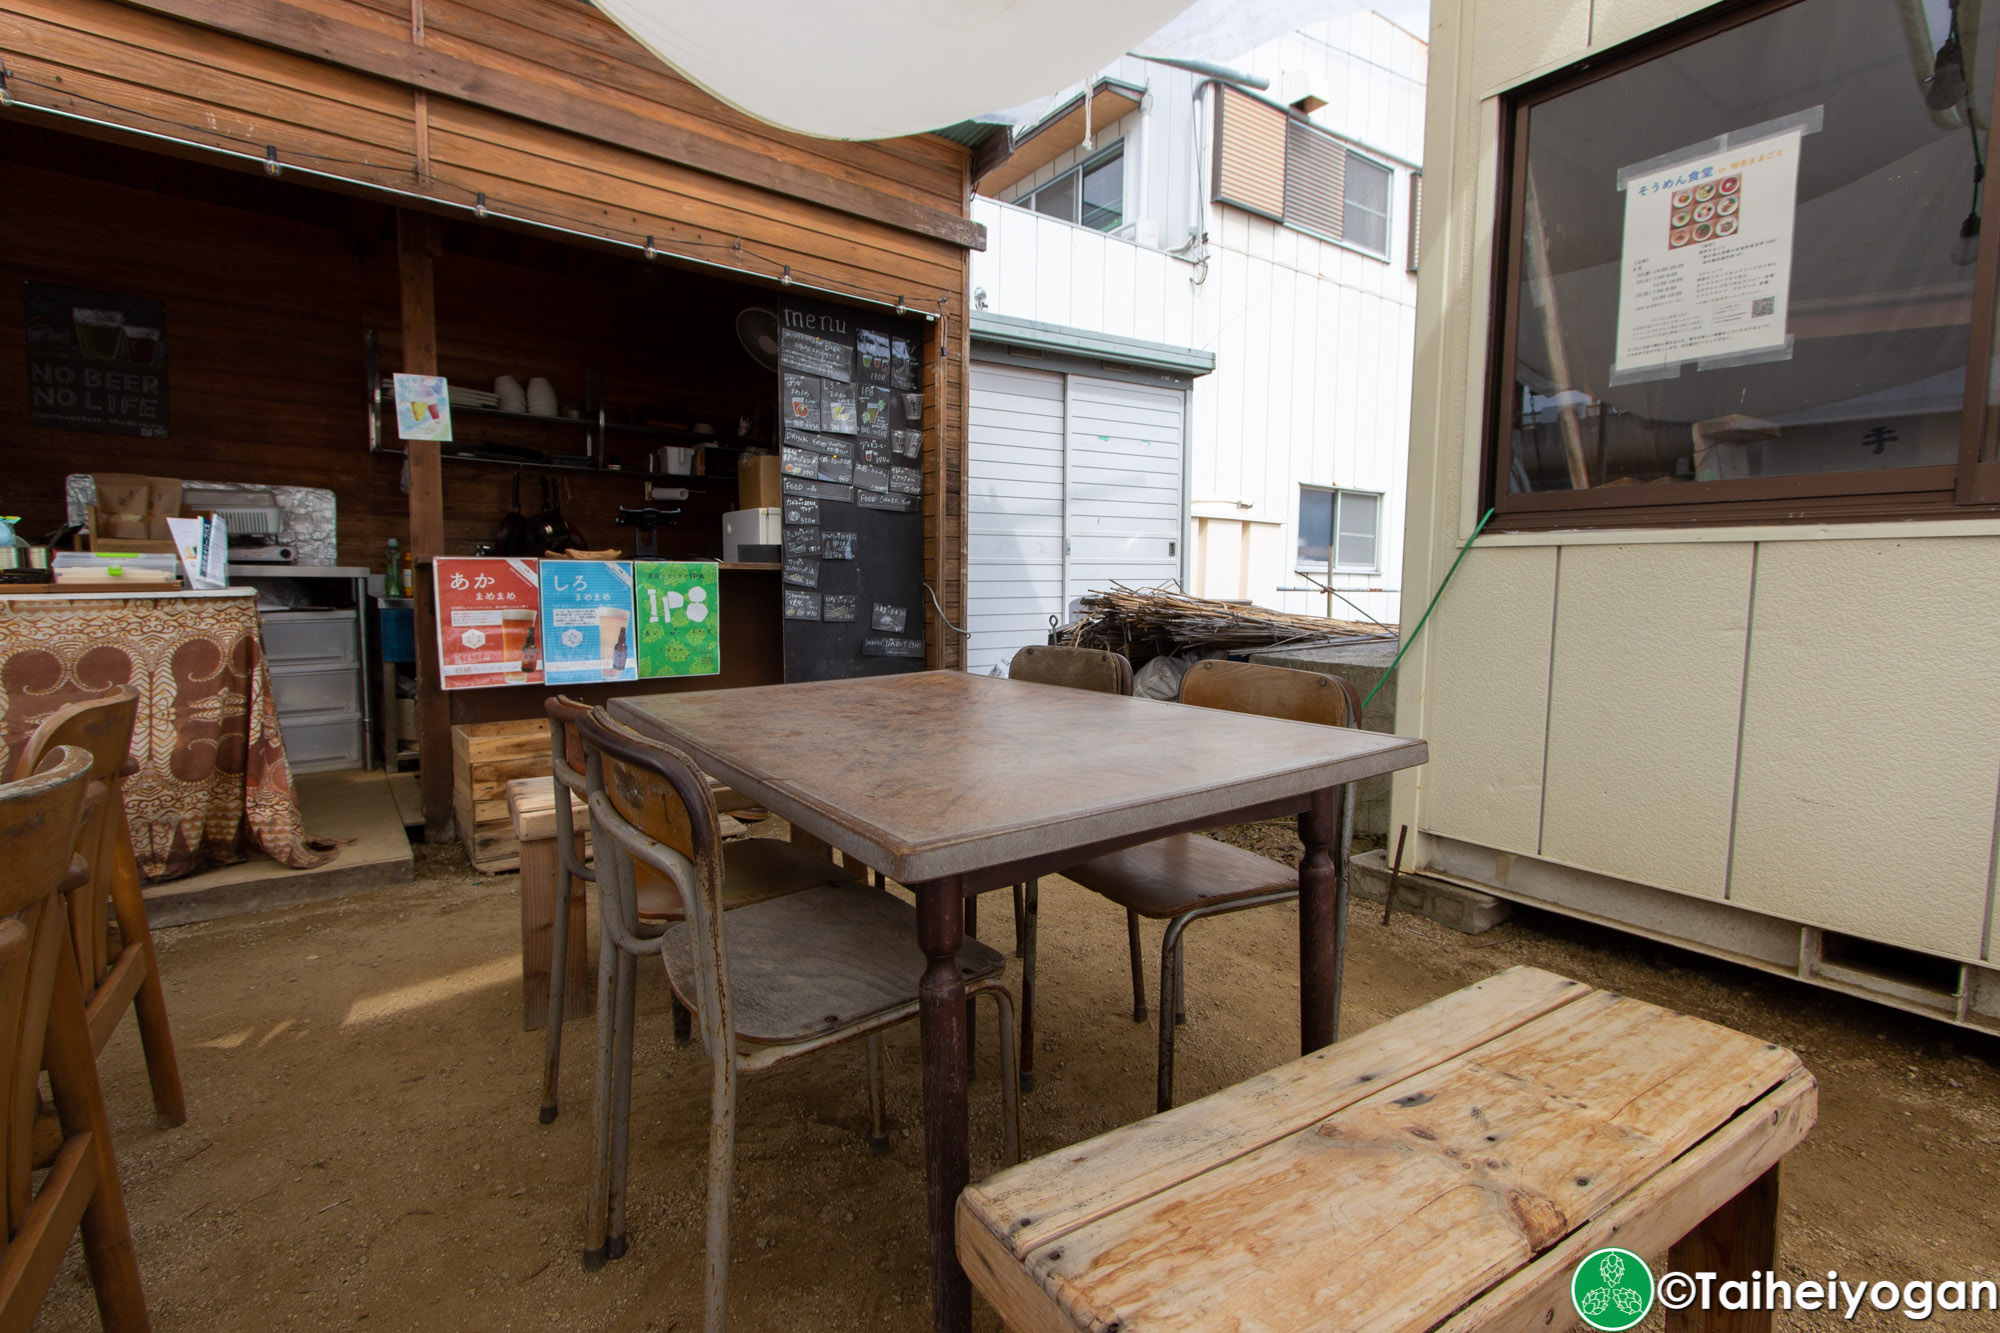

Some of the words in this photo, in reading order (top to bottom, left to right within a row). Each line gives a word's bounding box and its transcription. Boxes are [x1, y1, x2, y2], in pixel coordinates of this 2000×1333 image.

[1637, 165, 1714, 197] そうめん食堂
[783, 308, 847, 335] menu
[31, 362, 75, 384] NO
[84, 368, 160, 394] BEER
[32, 386, 77, 407] NO
[84, 391, 160, 419] LIFE
[449, 572, 495, 591] あか
[553, 574, 588, 591] しろ
[475, 590, 517, 602] まめまめ
[575, 591, 611, 603] まめまめ
[647, 585, 709, 624] IP8
